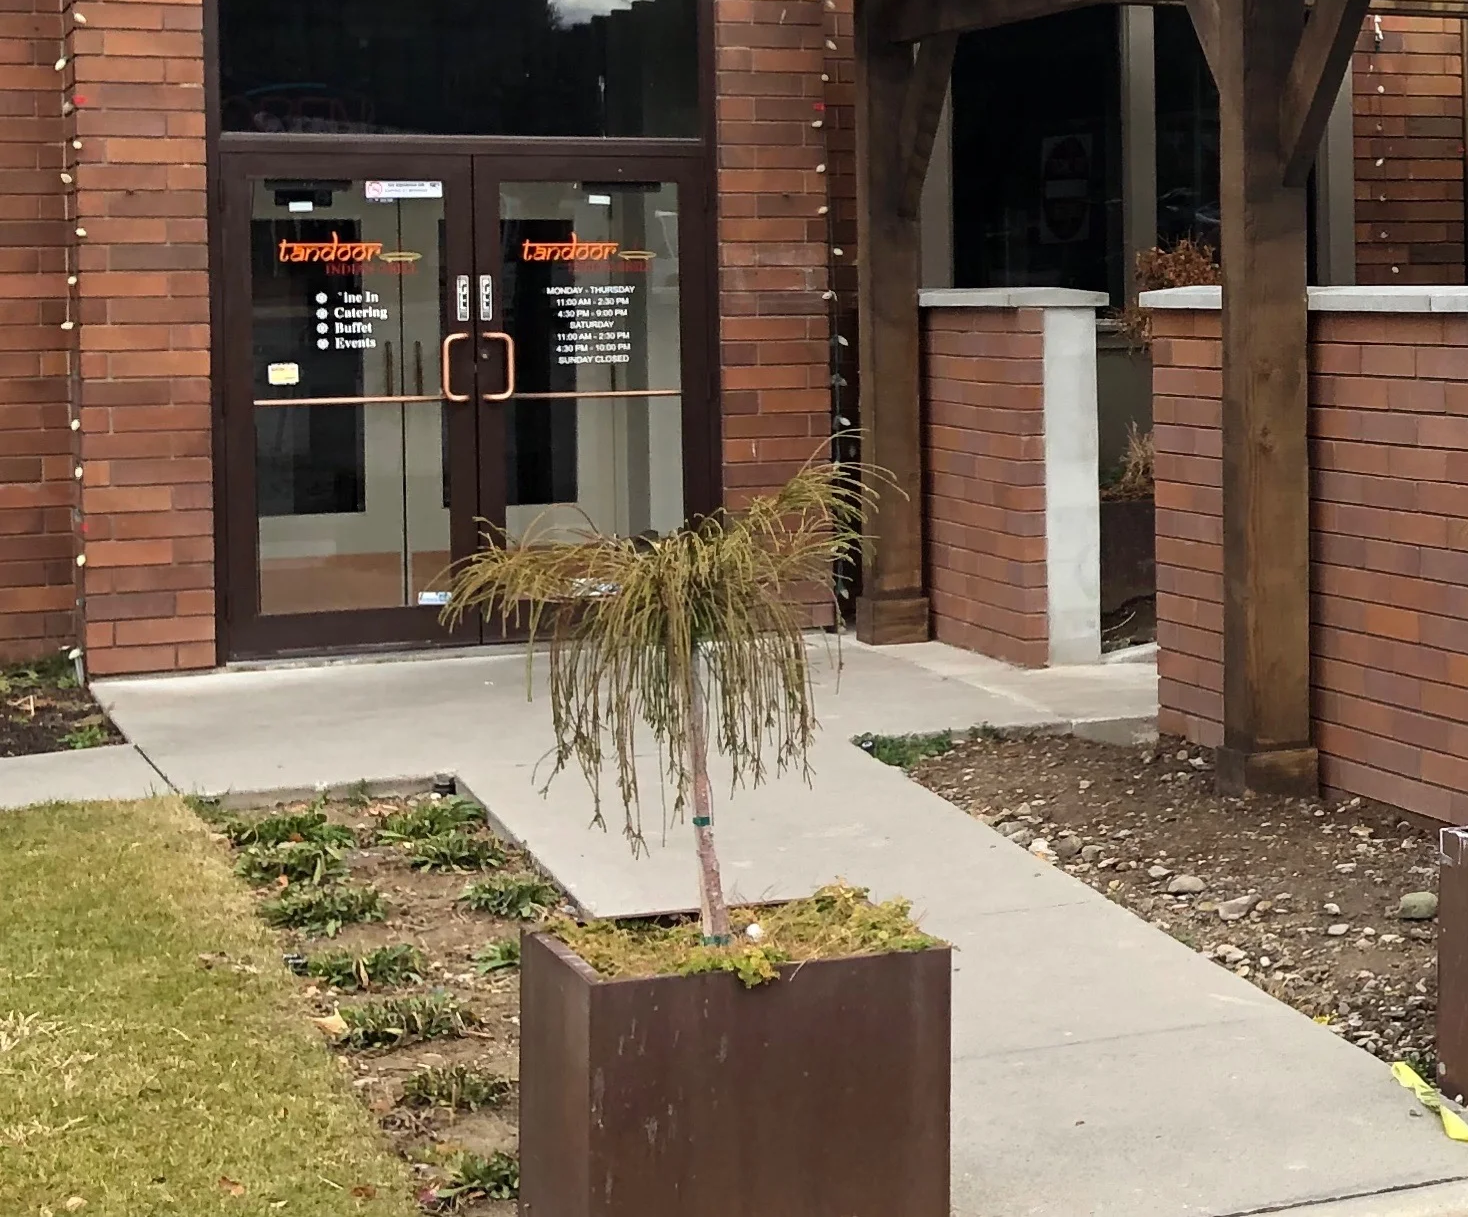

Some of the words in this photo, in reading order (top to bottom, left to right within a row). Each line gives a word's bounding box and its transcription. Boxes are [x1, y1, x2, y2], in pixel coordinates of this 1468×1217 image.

[279, 231, 383, 262] tandoor
[523, 231, 619, 261] tandoor
[546, 286, 583, 295] MONDAY
[590, 285, 635, 294] THURSDAY
[338, 291, 362, 303] ine
[365, 291, 379, 303] In
[556, 298, 577, 306] 11:00
[333, 306, 388, 320] Catering
[557, 310, 575, 318] 4:30
[335, 322, 373, 334] Buffet
[569, 321, 614, 329] SATURDAY
[557, 333, 578, 341] 11:00
[598, 332, 615, 340] 2:30
[335, 337, 377, 349] Events
[556, 344, 574, 352] 4:30
[575, 344, 588, 352] PM
[595, 343, 616, 351] 10:00
[558, 356, 593, 364] SUNDAY
[595, 355, 630, 363] CLOSED
